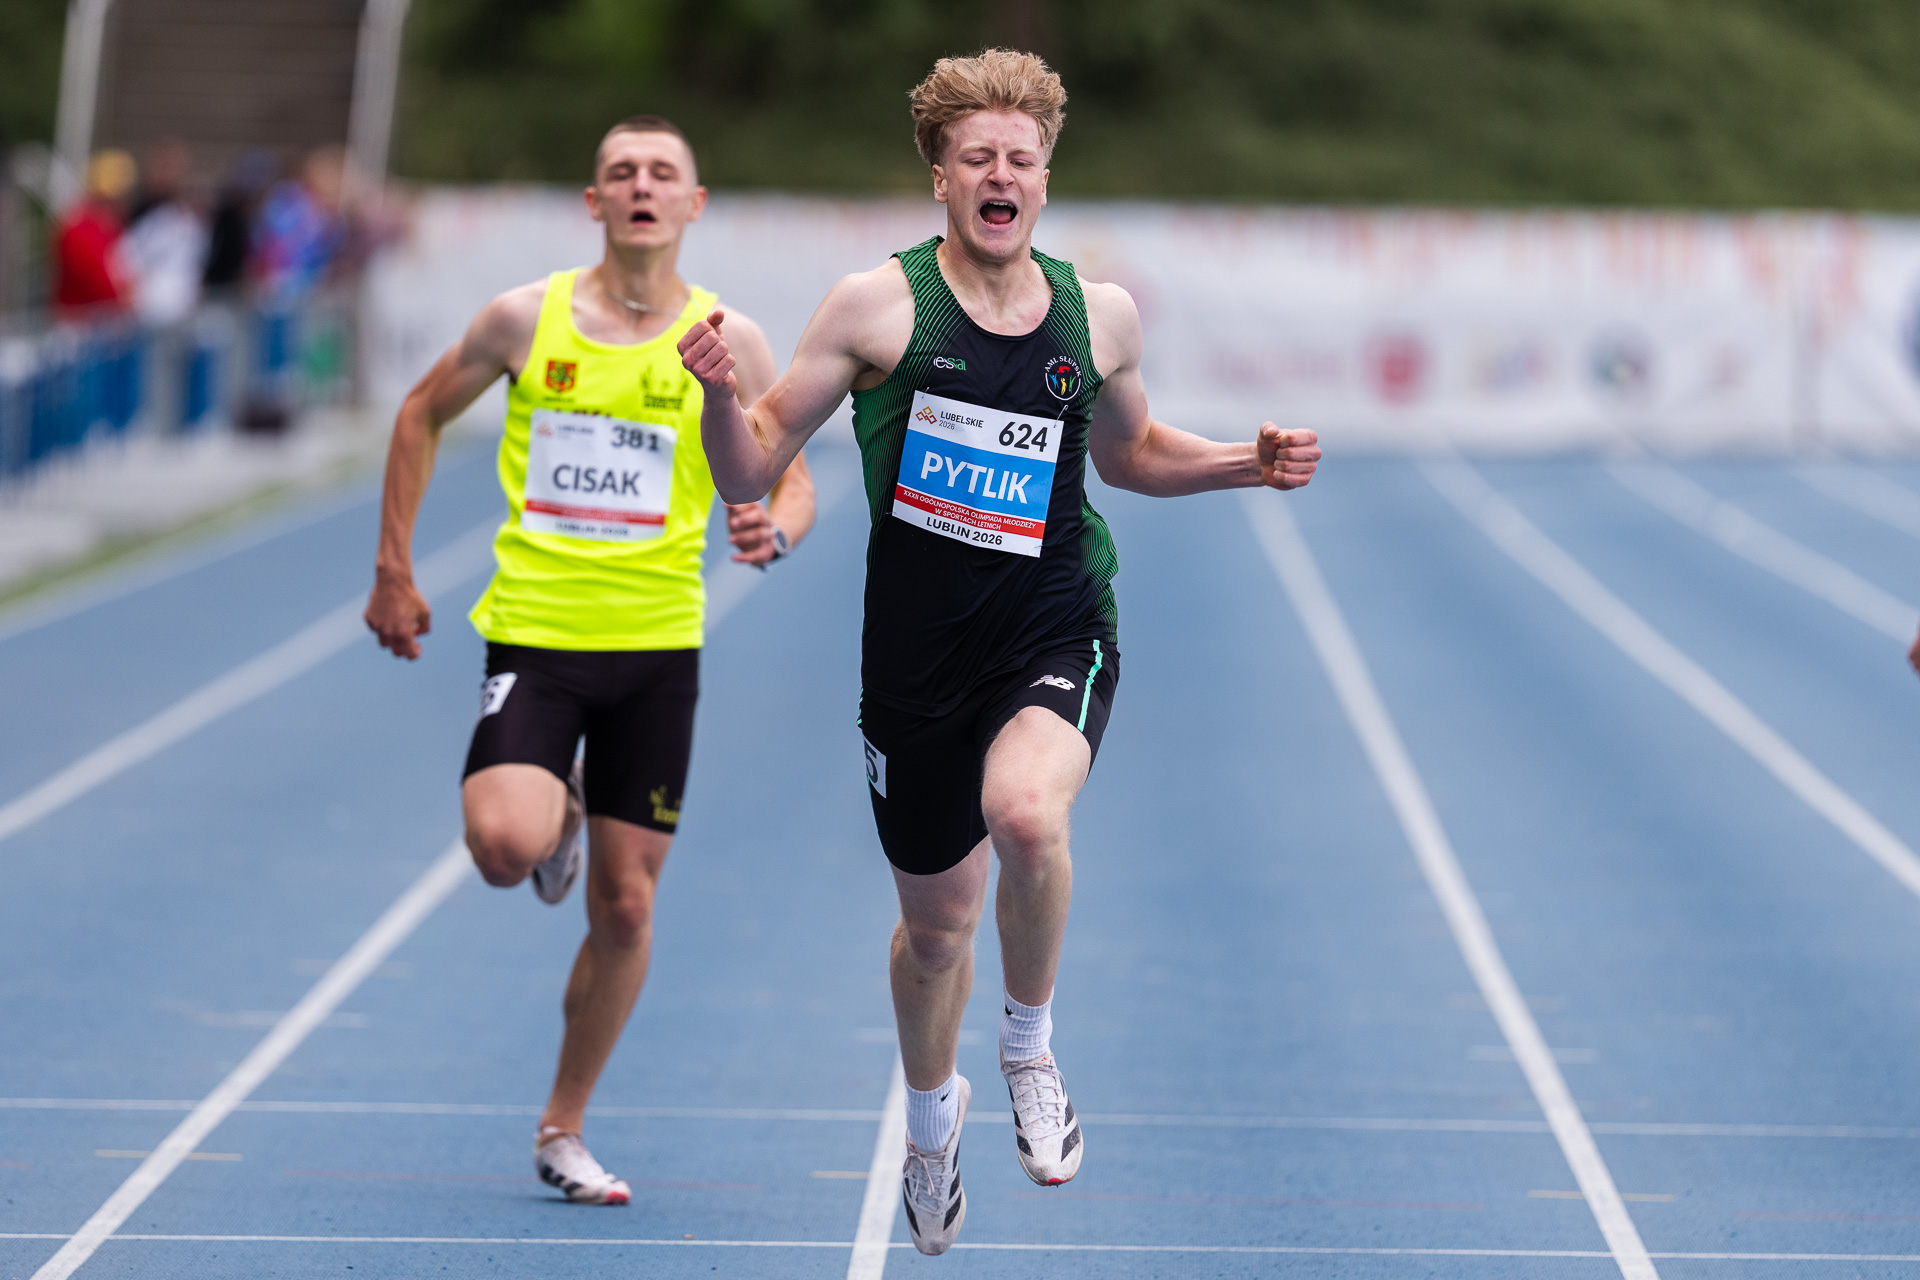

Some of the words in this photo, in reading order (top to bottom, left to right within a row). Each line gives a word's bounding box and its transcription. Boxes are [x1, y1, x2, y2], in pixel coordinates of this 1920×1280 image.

[939, 419, 956, 431] 2026
[940, 411, 984, 428] LUBELSKIE
[610, 425, 661, 451] 381
[999, 421, 1049, 452] 624
[553, 464, 641, 496] CISAK
[920, 451, 1033, 504] PYTLIK
[926, 516, 970, 538] LUBLIN
[971, 530, 1003, 546] 2026
[935, 507, 943, 515] W
[942, 510, 977, 526] SPORTACH
[977, 521, 1002, 530] LETNICH
[970, 511, 1002, 523] OLIMPIADA
[864, 740, 878, 784] 5
